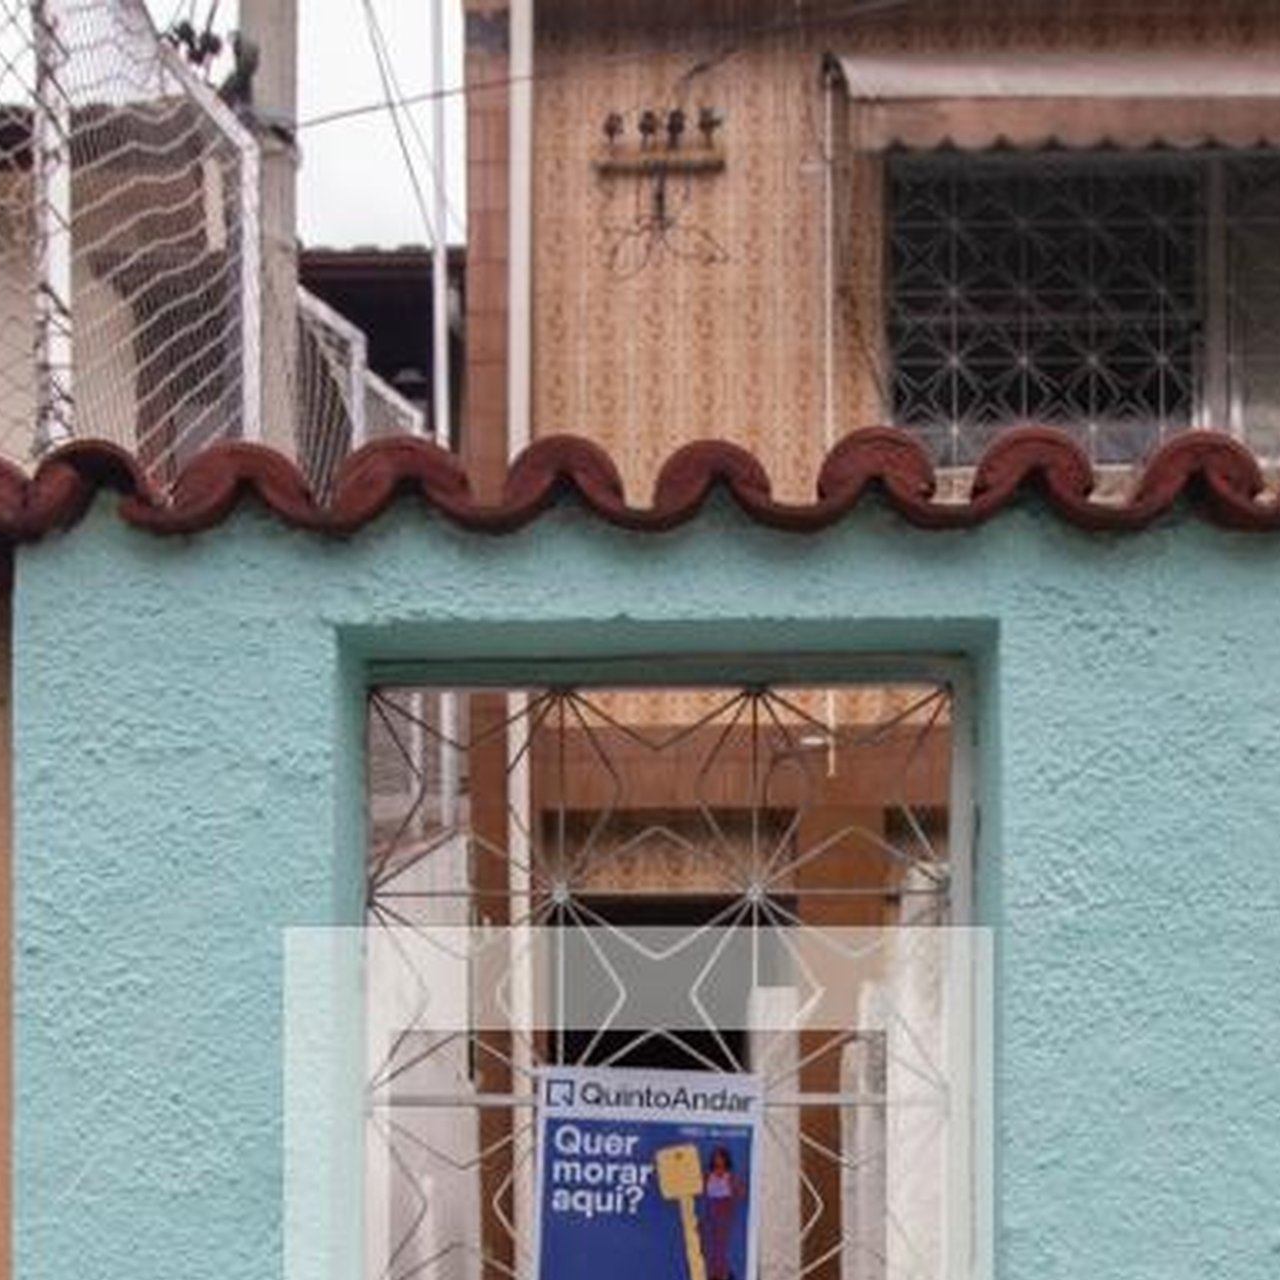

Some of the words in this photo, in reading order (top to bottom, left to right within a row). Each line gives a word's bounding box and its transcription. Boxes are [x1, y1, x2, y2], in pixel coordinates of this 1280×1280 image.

[581, 1081, 755, 1112] QuintoAndar
[554, 1125, 639, 1156] Quer
[553, 1161, 654, 1185] morar
[552, 1185, 644, 1218] aqui?
